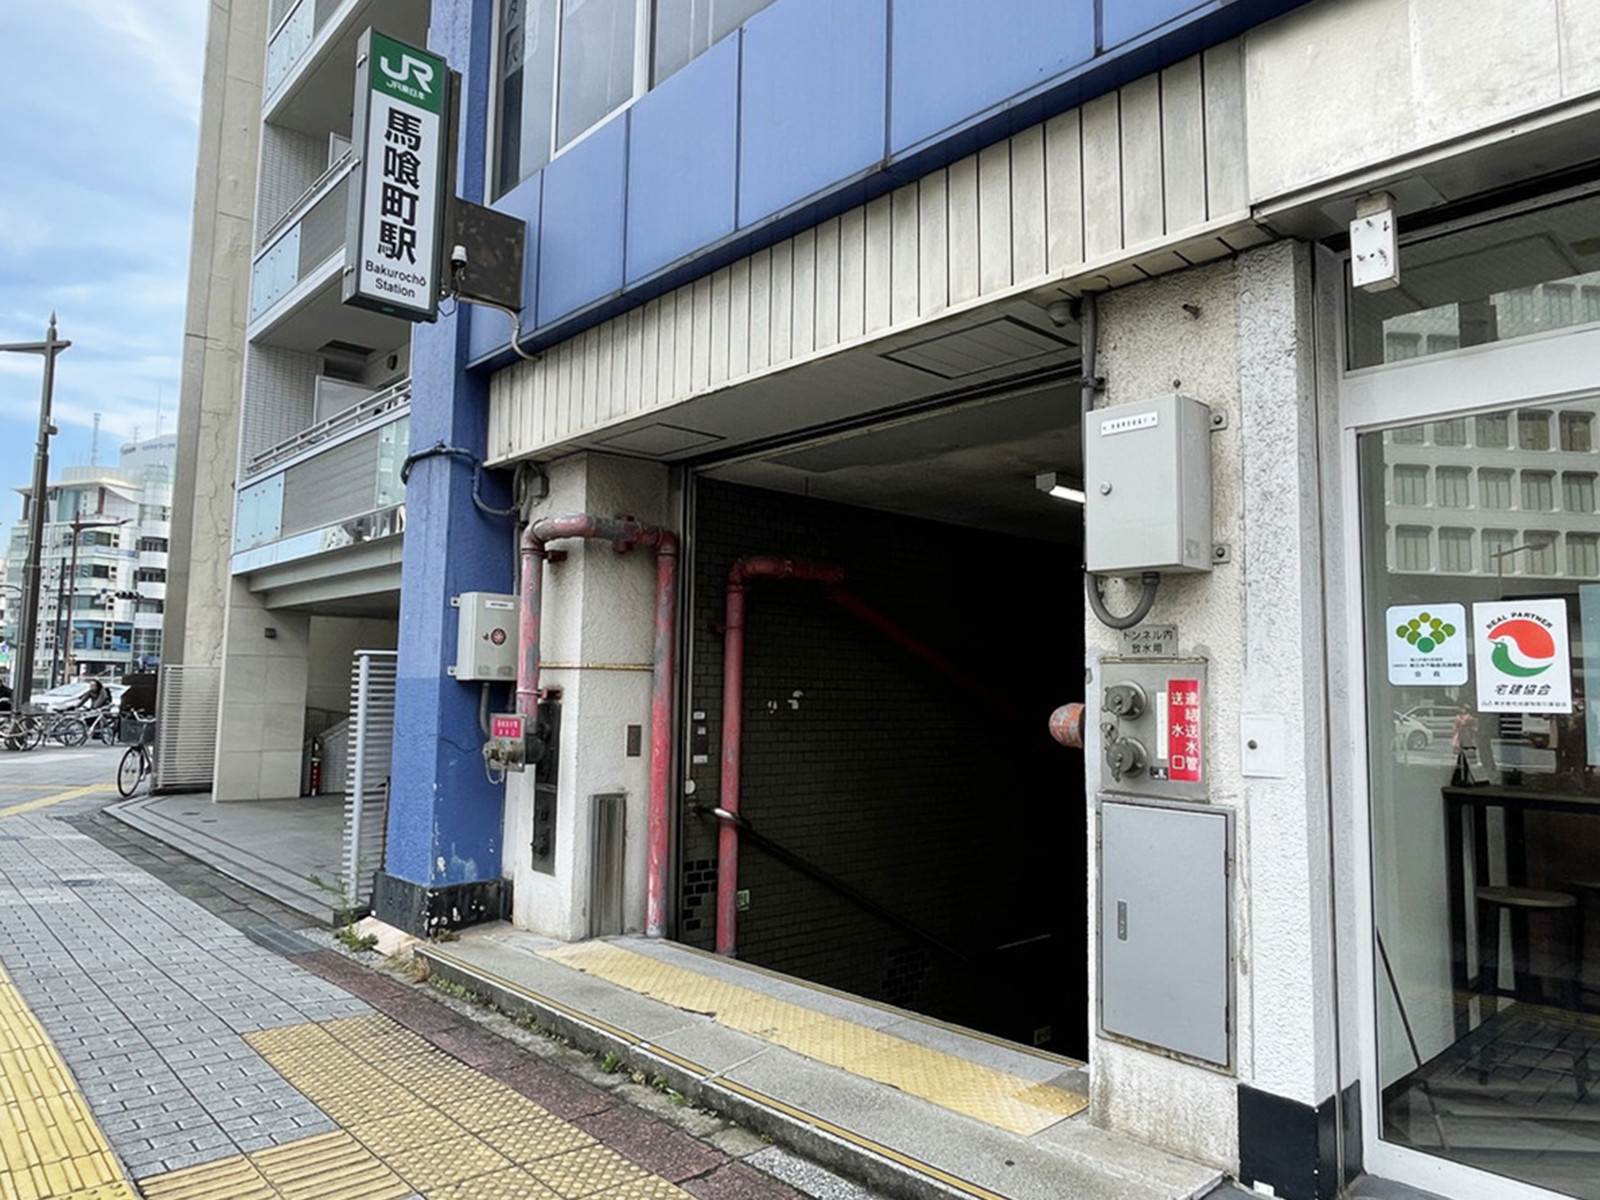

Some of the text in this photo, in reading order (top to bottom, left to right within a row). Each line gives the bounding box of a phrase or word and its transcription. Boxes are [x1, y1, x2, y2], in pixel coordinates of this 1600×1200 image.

[380, 54, 434, 93] JR
[377, 107, 422, 266] 馬喰町駅
[375, 277, 416, 298] Station
[1511, 612, 1553, 629] PARTNER
[1123, 630, 1173, 641] トンネル内
[1494, 683, 1552, 696] 宅建協会
[1171, 691, 1186, 770] 送水口
